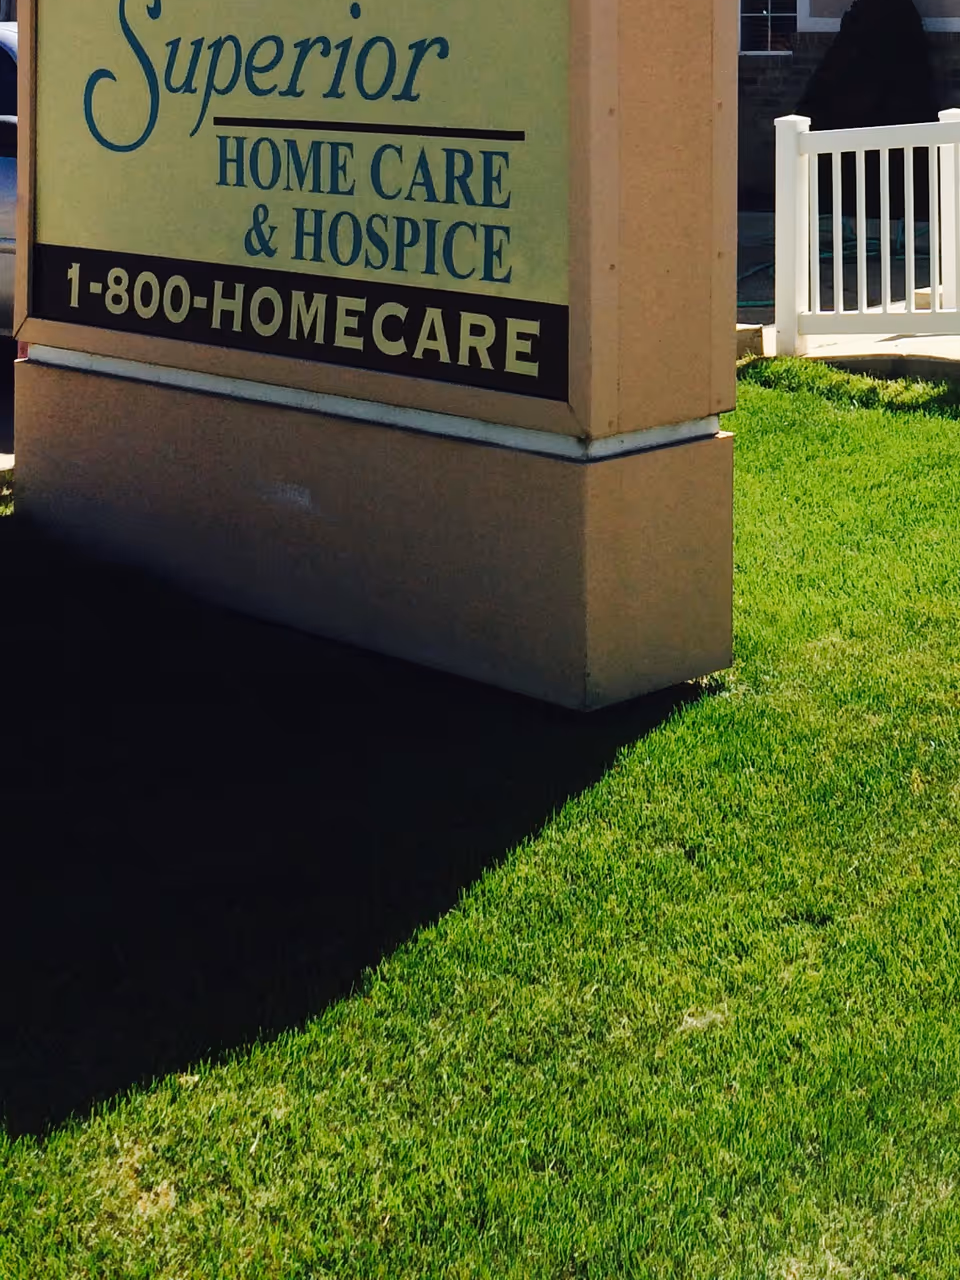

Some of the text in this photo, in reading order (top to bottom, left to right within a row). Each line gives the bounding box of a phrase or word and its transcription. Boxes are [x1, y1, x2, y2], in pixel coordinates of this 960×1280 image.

[215, 135, 512, 209] HOME CARE
[244, 203, 512, 284] & HOSPICE
[66, 262, 541, 378] 1-800-HOMECARE
